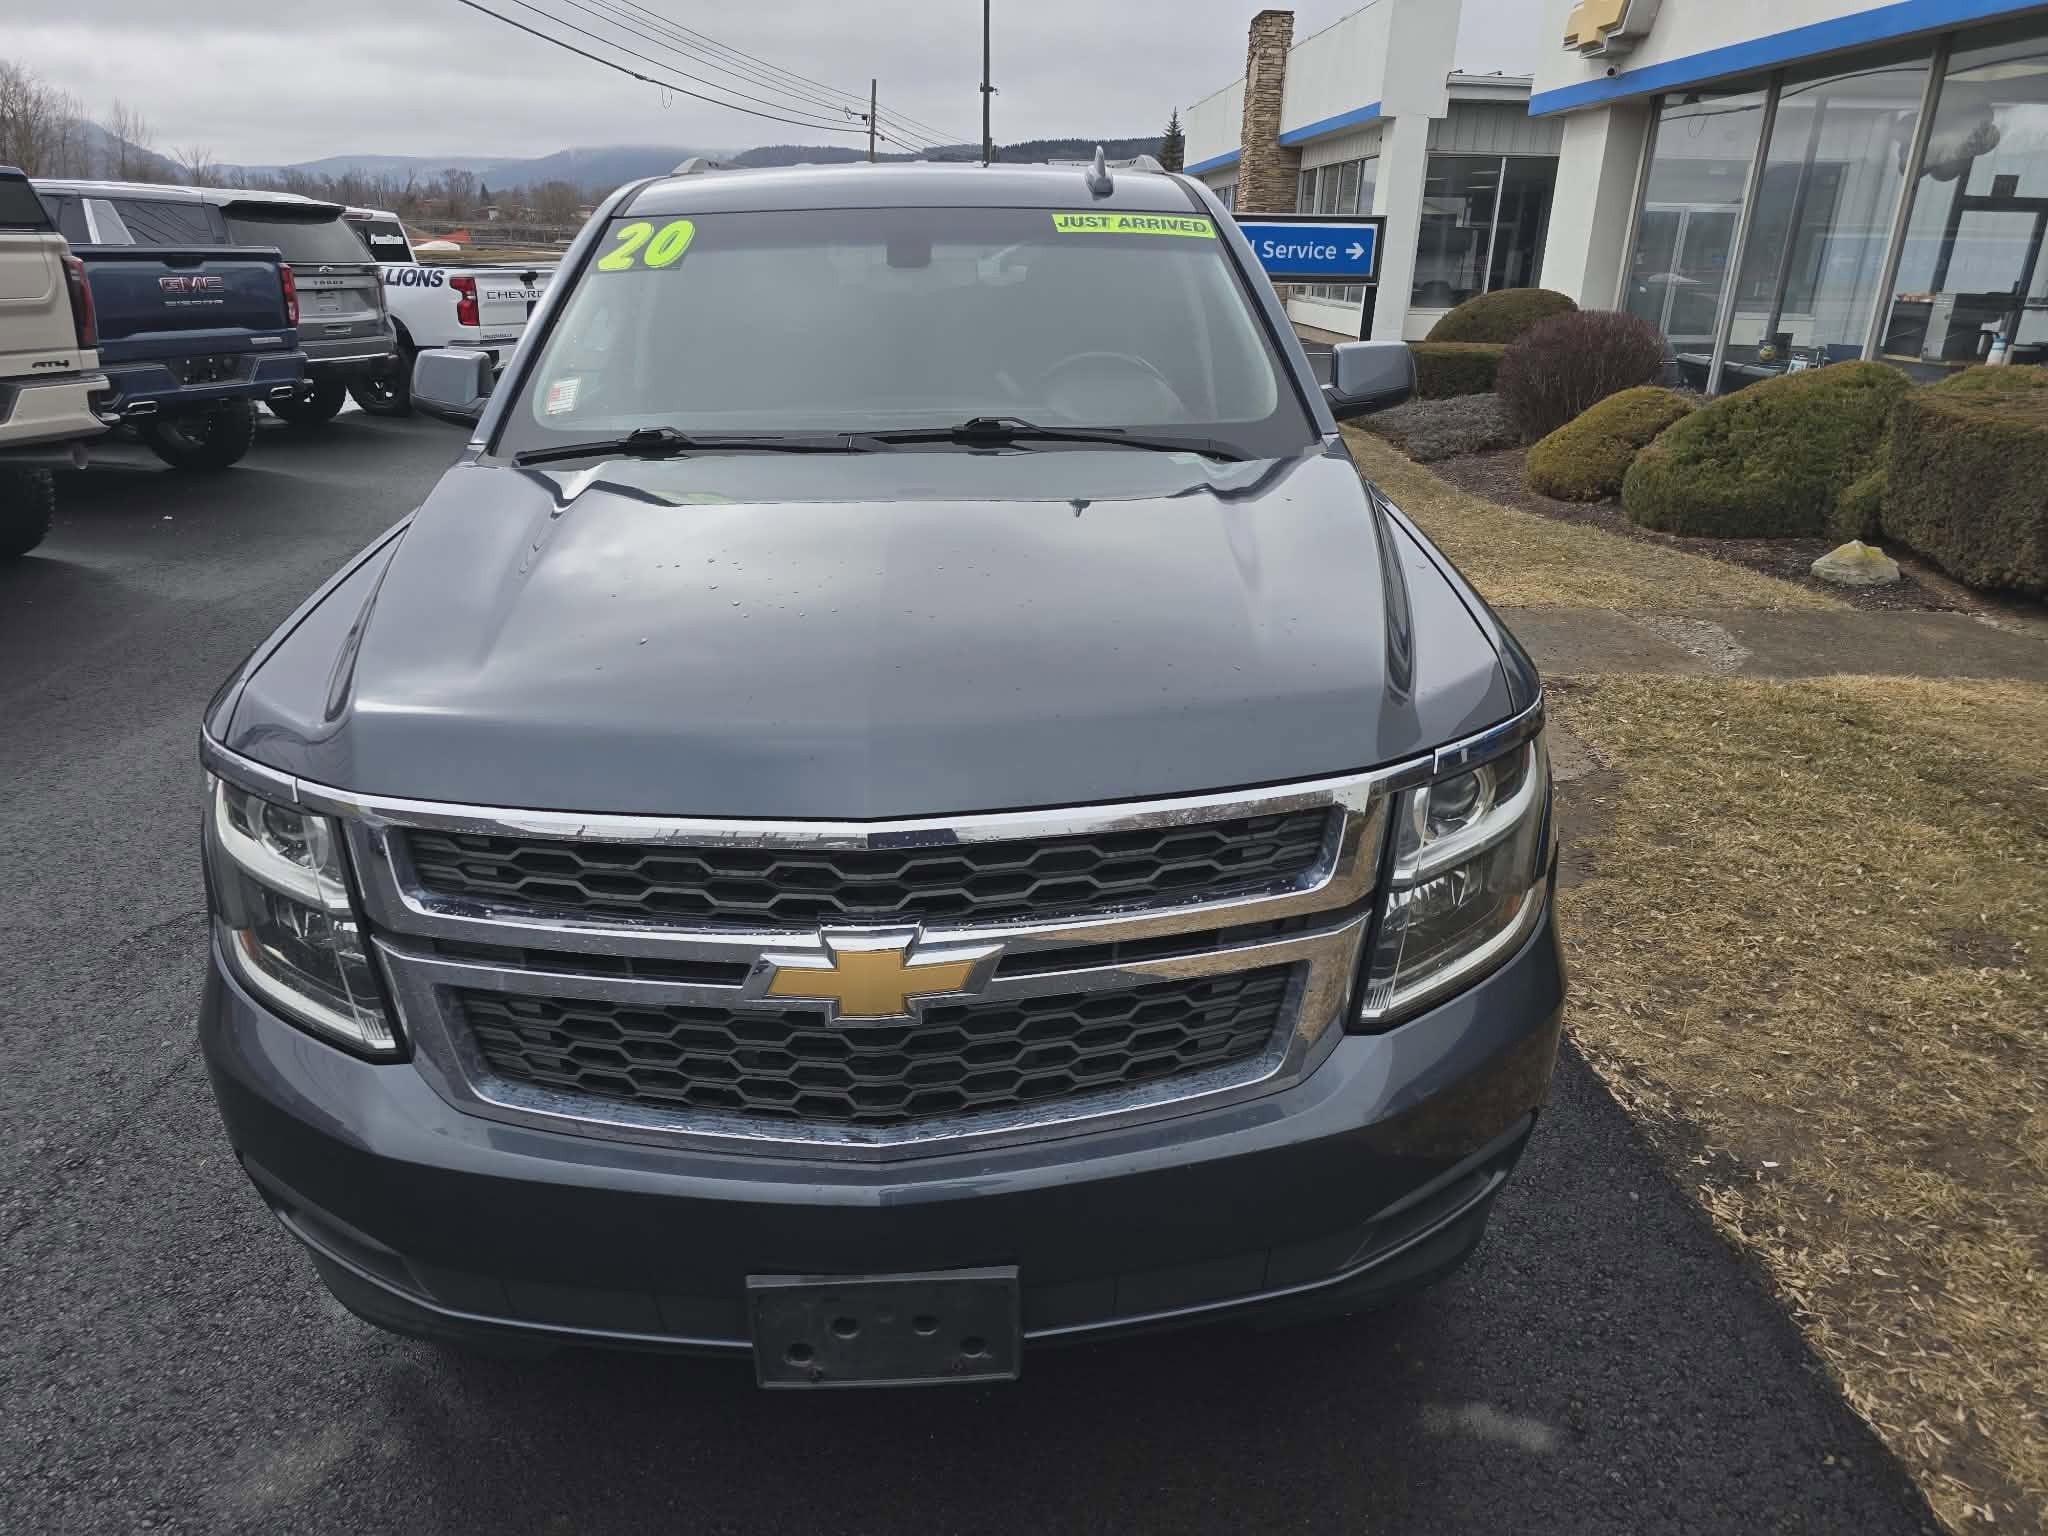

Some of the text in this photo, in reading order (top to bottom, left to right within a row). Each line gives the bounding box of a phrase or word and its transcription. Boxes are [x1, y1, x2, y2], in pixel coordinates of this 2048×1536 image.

[1058, 216, 1207, 232] JUST ARRIVED
[598, 220, 695, 271] 20
[1262, 240, 1337, 260] Service
[159, 276, 224, 293] GMC
[384, 269, 445, 287] LIONS
